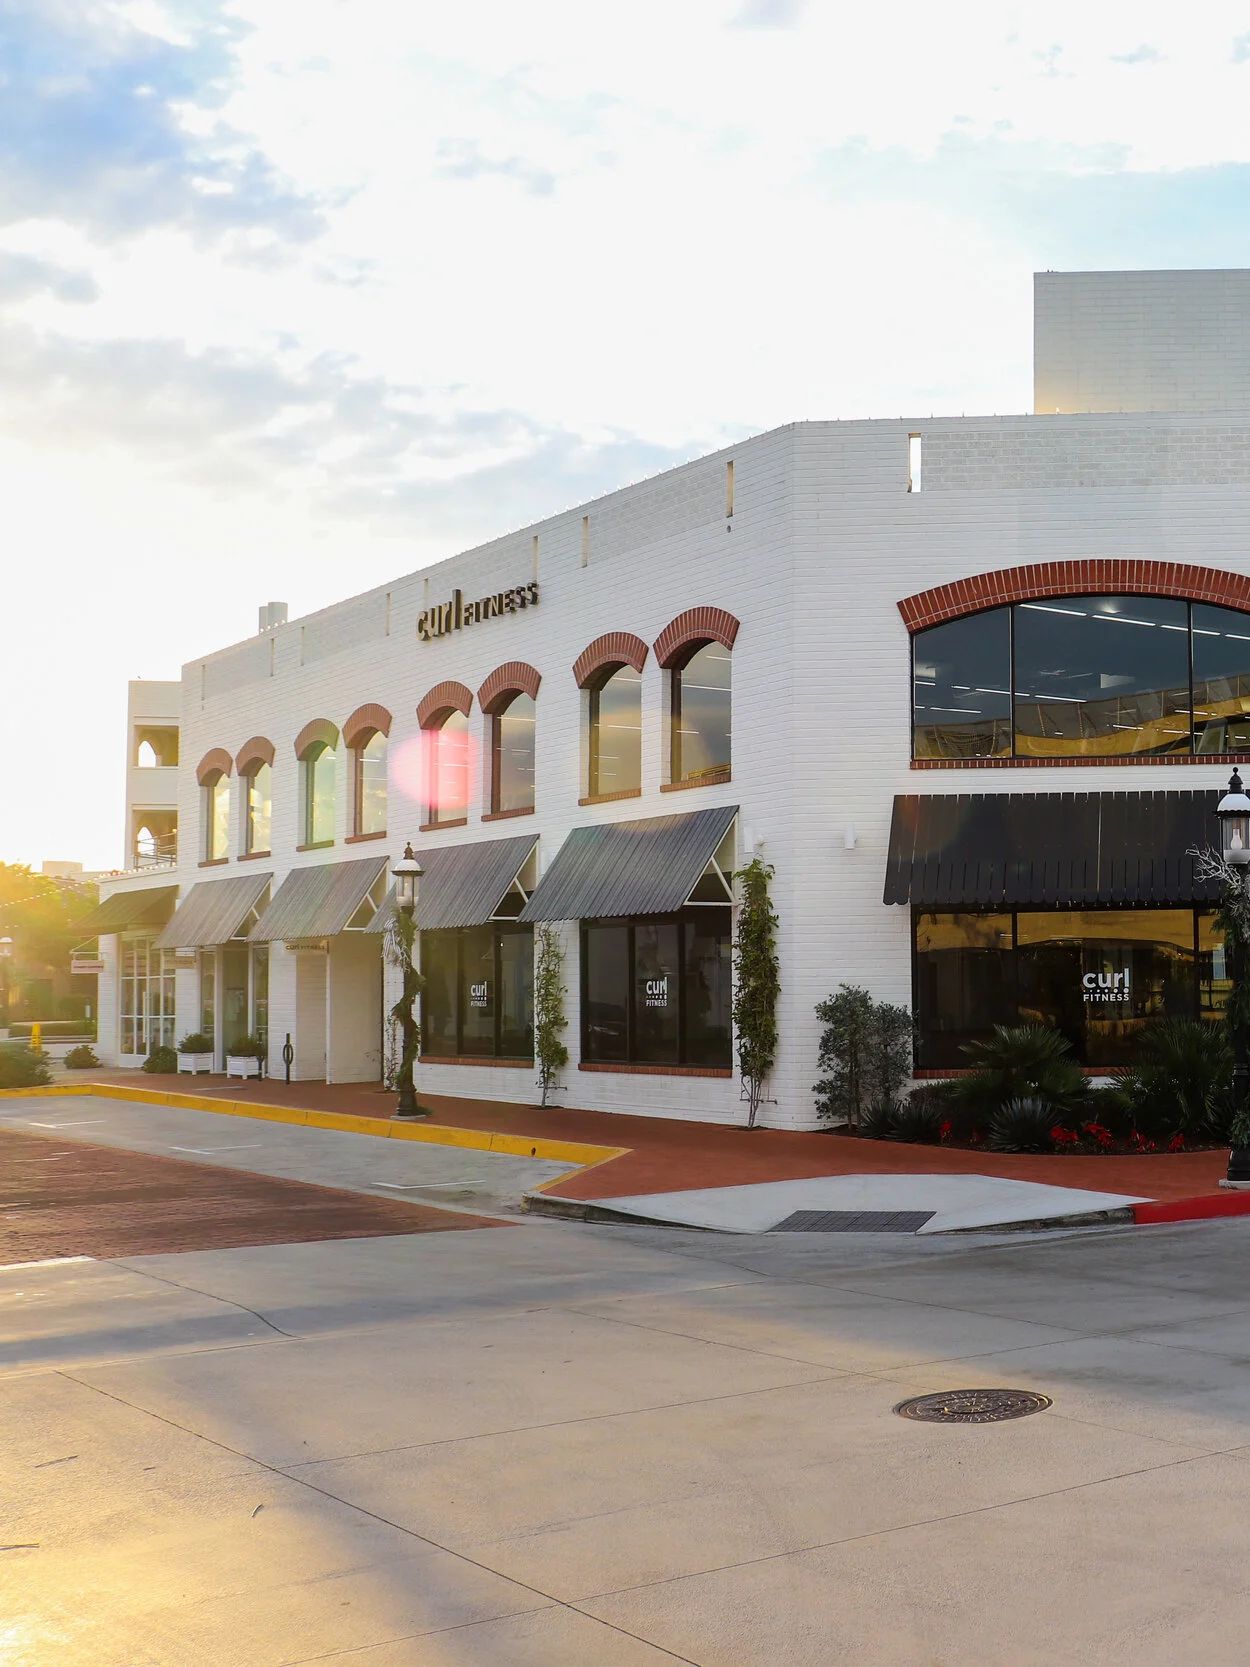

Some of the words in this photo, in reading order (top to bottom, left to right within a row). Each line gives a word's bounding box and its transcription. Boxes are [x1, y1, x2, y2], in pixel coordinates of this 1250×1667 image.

[416, 589, 462, 641] curl
[463, 582, 539, 626] FITNESS
[646, 976, 667, 994] curl
[1082, 968, 1130, 988] curl
[471, 981, 487, 996] curl
[1083, 994, 1129, 1002] FITNESS
